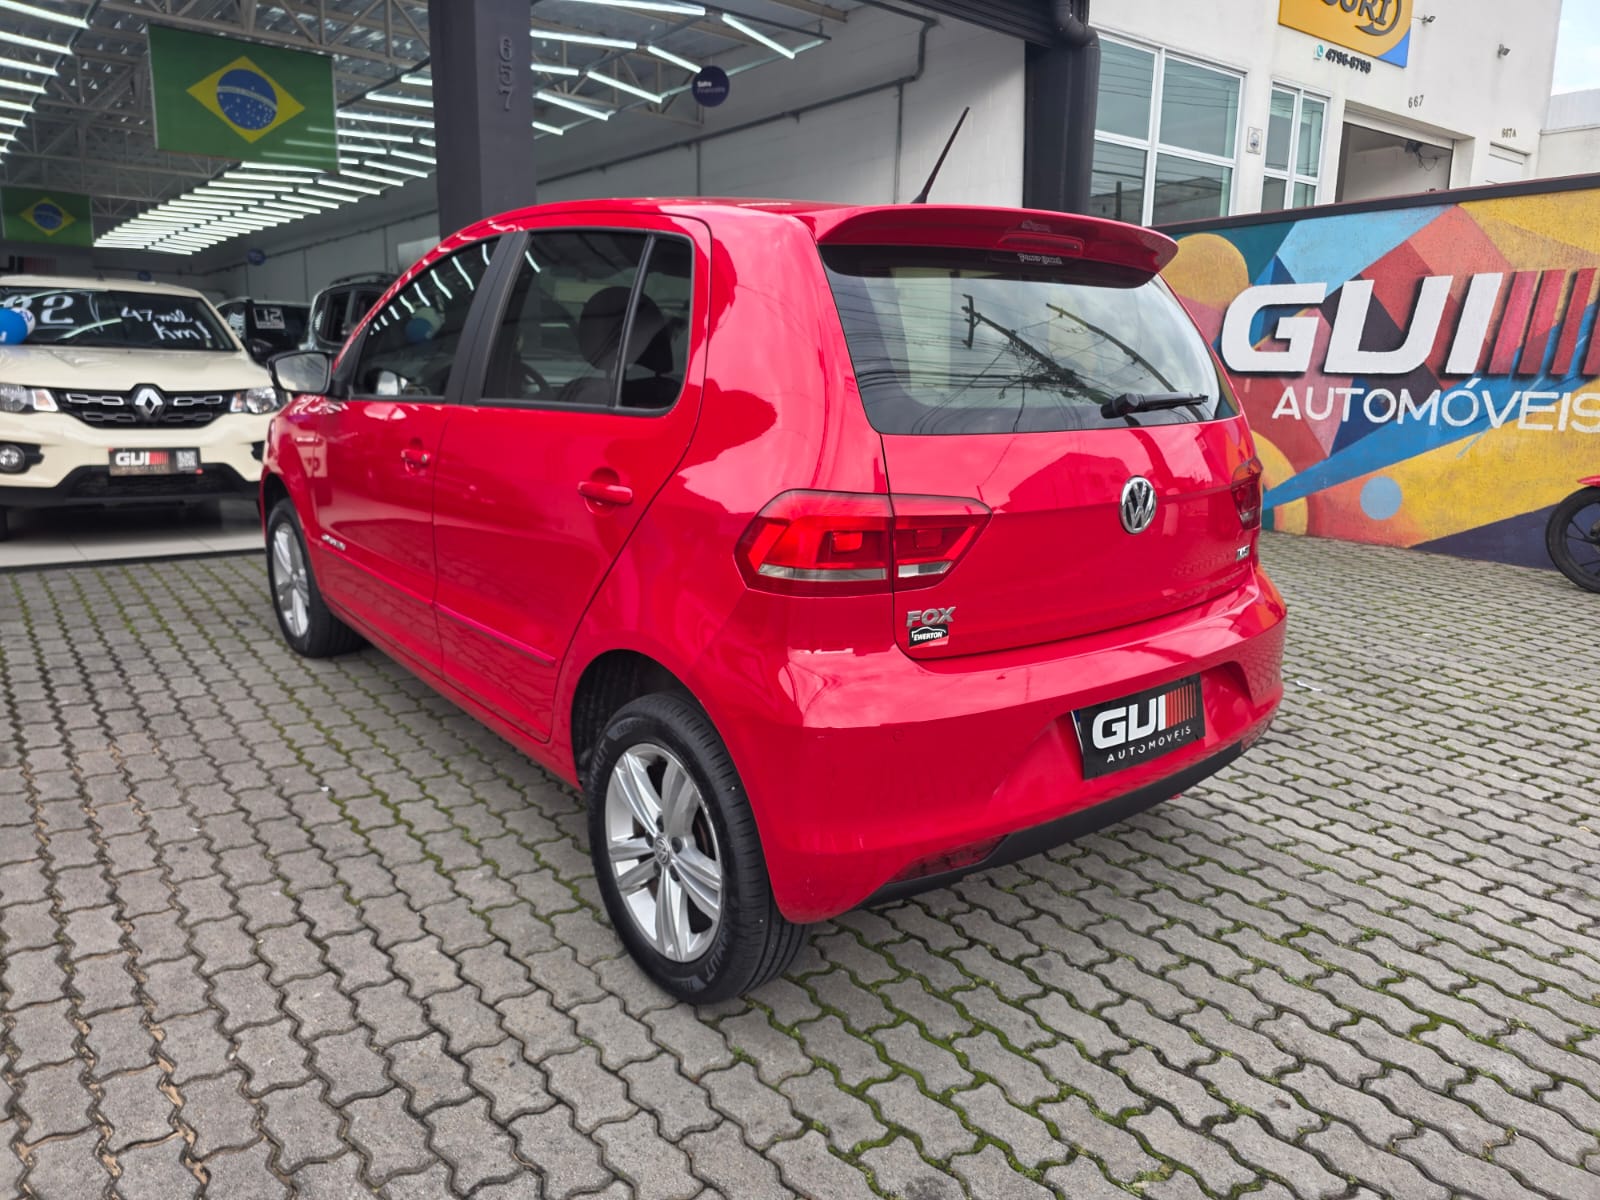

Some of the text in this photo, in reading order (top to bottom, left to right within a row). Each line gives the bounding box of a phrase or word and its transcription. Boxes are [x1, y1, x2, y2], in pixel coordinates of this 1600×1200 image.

[1408, 95, 1424, 108] 667
[1221, 273, 1503, 374] GUI
[1272, 378, 1600, 433] AUTOMÓVEIS
[115, 451, 150, 466] GUI
[906, 606, 957, 627] FOX
[1092, 694, 1167, 750] GUI
